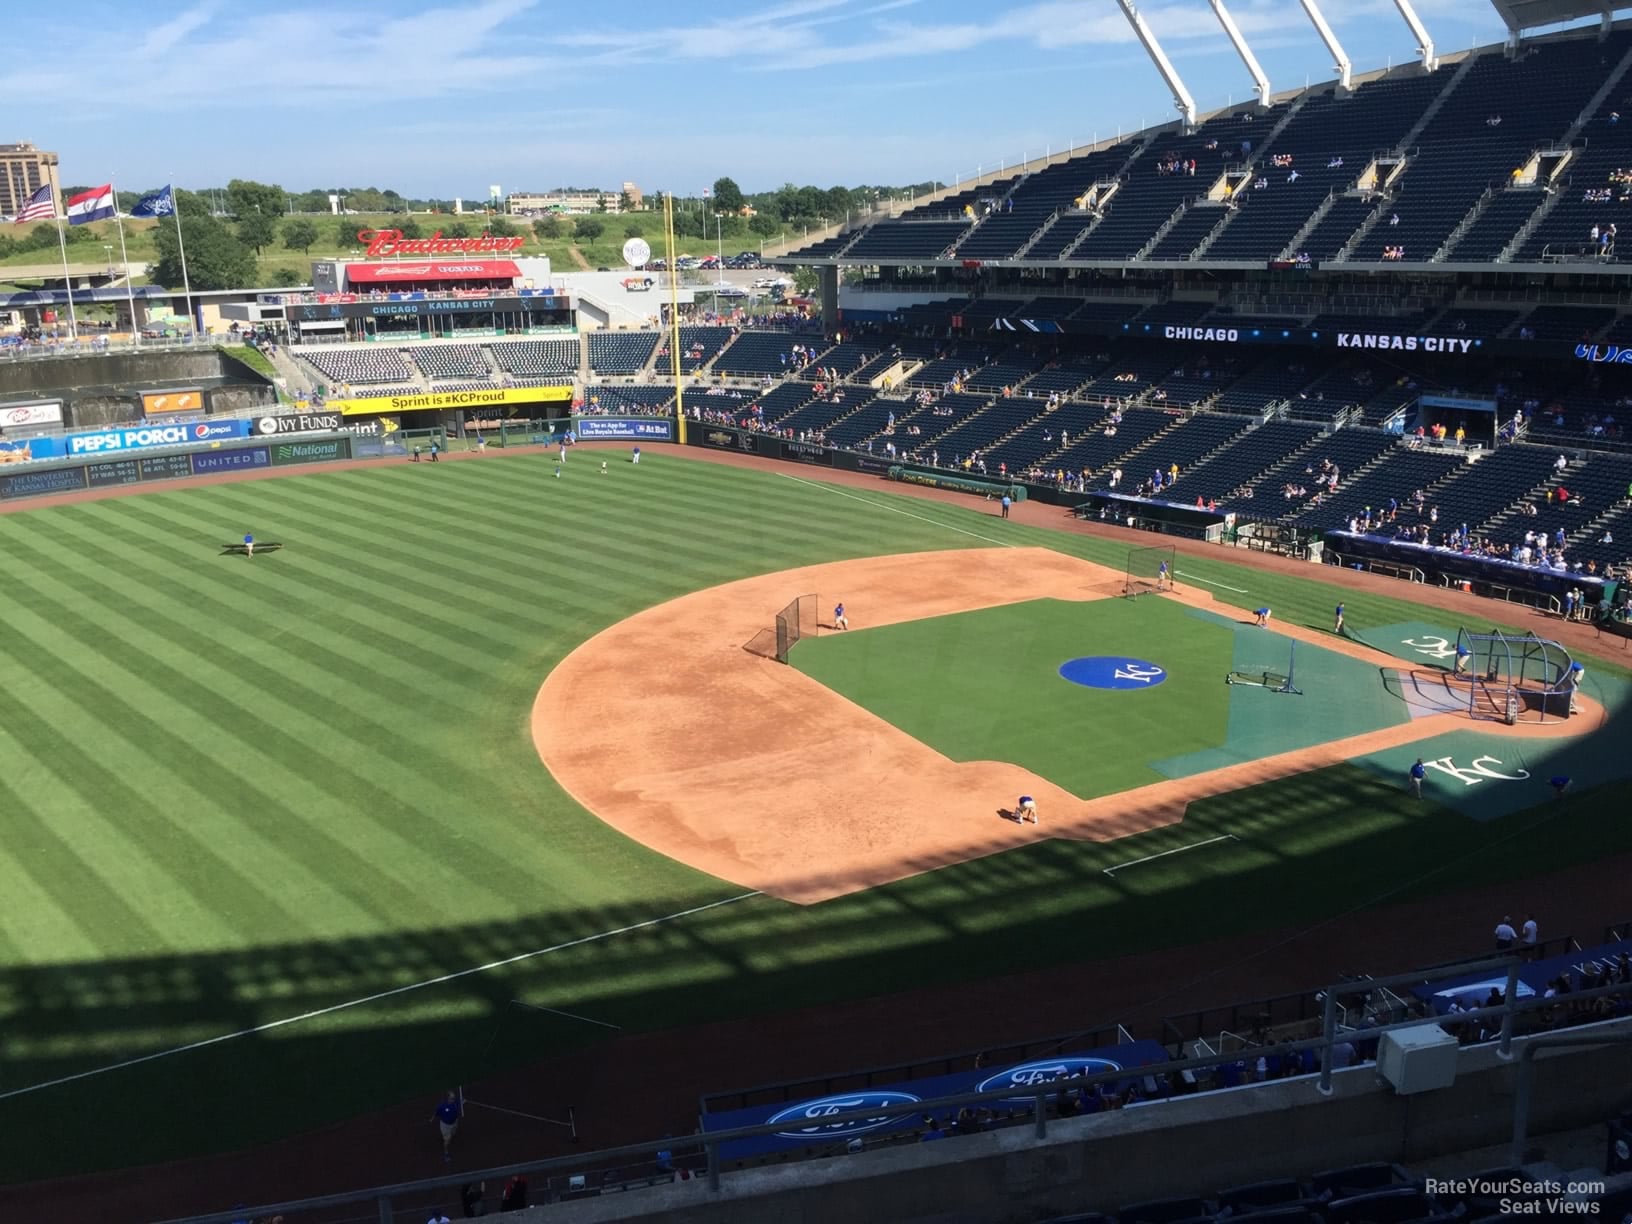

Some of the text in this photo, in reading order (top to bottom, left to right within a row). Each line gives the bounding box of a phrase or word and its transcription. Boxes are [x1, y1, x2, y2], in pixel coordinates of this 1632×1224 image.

[357, 228, 525, 257] Budweiser
[373, 305, 418, 314] CHICAGO
[429, 301, 469, 310] KANSAS
[1165, 326, 1238, 342] CHICAGO
[1337, 333, 1473, 353] KANSAS CITY
[392, 391, 505, 408] Sprint is #KCProud
[471, 407, 503, 418] Sprint
[210, 425, 231, 435] pepsi
[277, 415, 338, 432] IVY FUNDS
[646, 425, 667, 434] At Bat
[72, 426, 187, 452] PEPSI PORCH
[292, 444, 337, 457] National
[198, 455, 251, 468] UNITED
[14, 482, 45, 492] KANSAS
[47, 478, 83, 488] HOSPITAL
[26, 471, 75, 484] UNIVERSITY
[1402, 635, 1457, 659] KC
[1115, 663, 1163, 682] KC
[1424, 755, 1530, 786] KC
